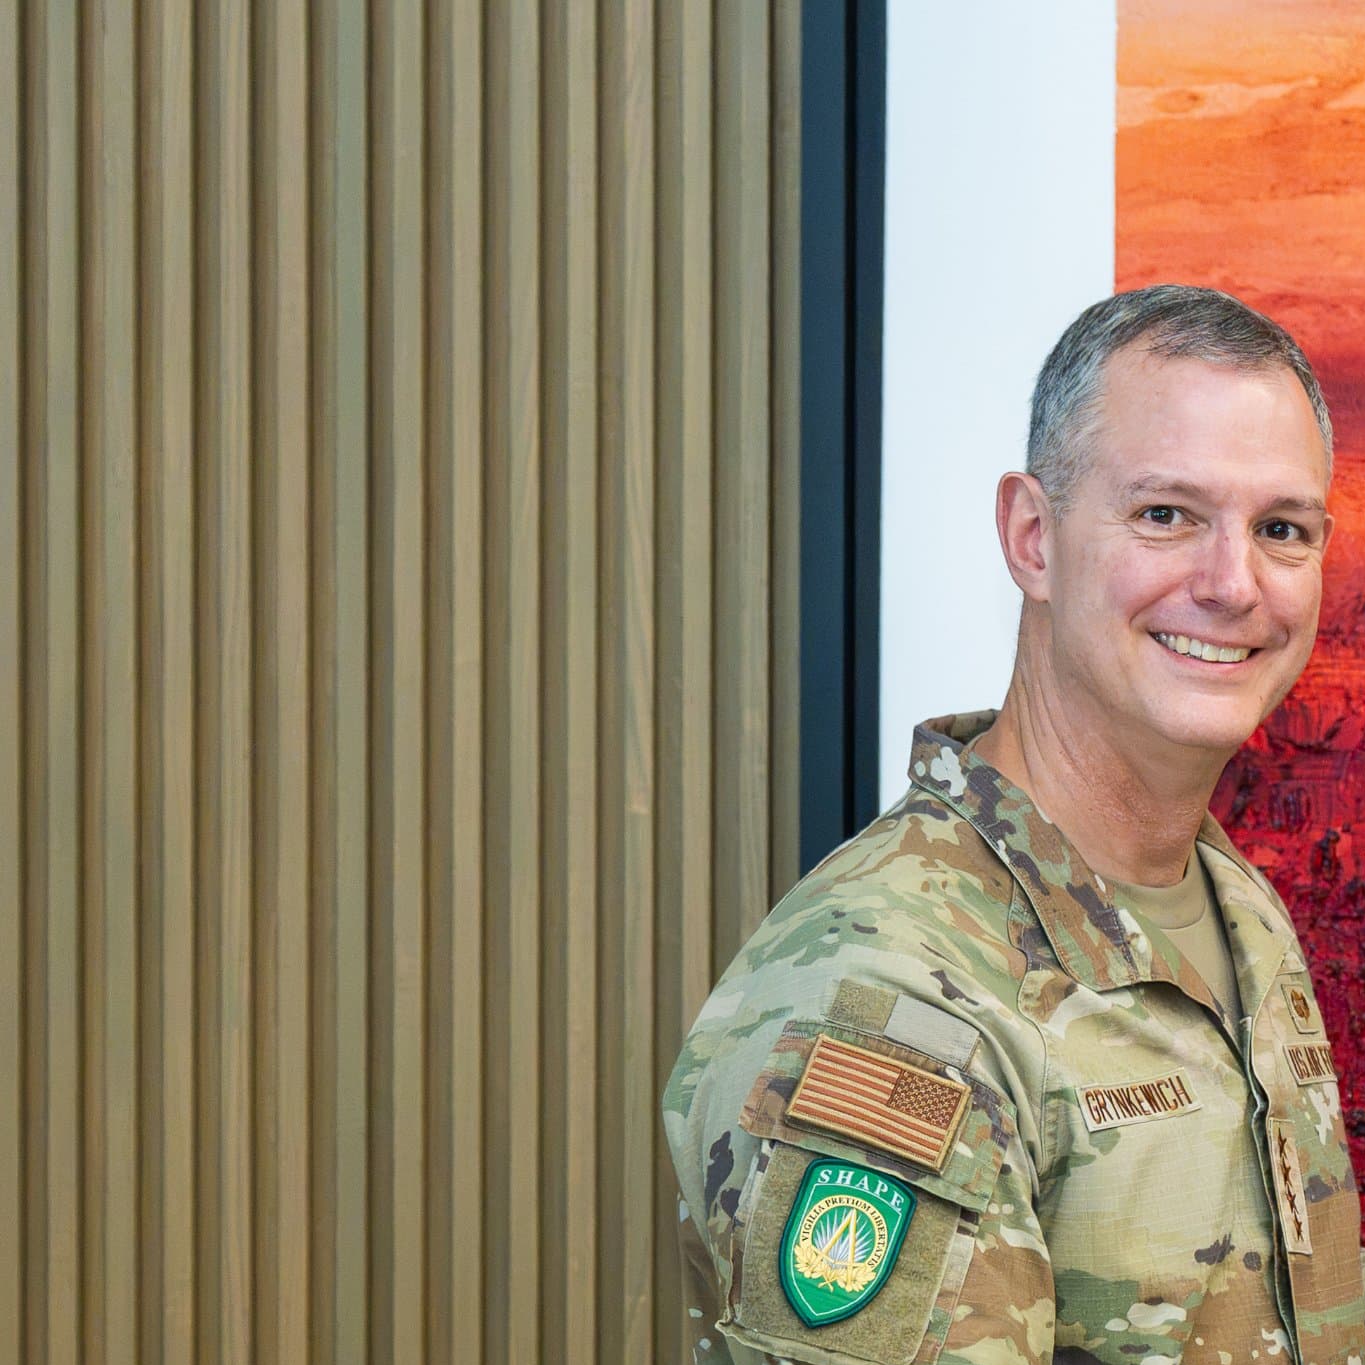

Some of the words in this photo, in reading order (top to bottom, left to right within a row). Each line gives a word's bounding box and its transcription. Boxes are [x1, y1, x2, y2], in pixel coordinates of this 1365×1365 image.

[1288, 1047, 1310, 1079] US
[1084, 1075, 1193, 1125] GRYNKEWICH
[817, 1168, 905, 1213] SHAPE
[801, 1204, 826, 1242] VIGILIA
[824, 1196, 871, 1212] PRETIUM
[867, 1210, 887, 1268] LIBERTATIS
